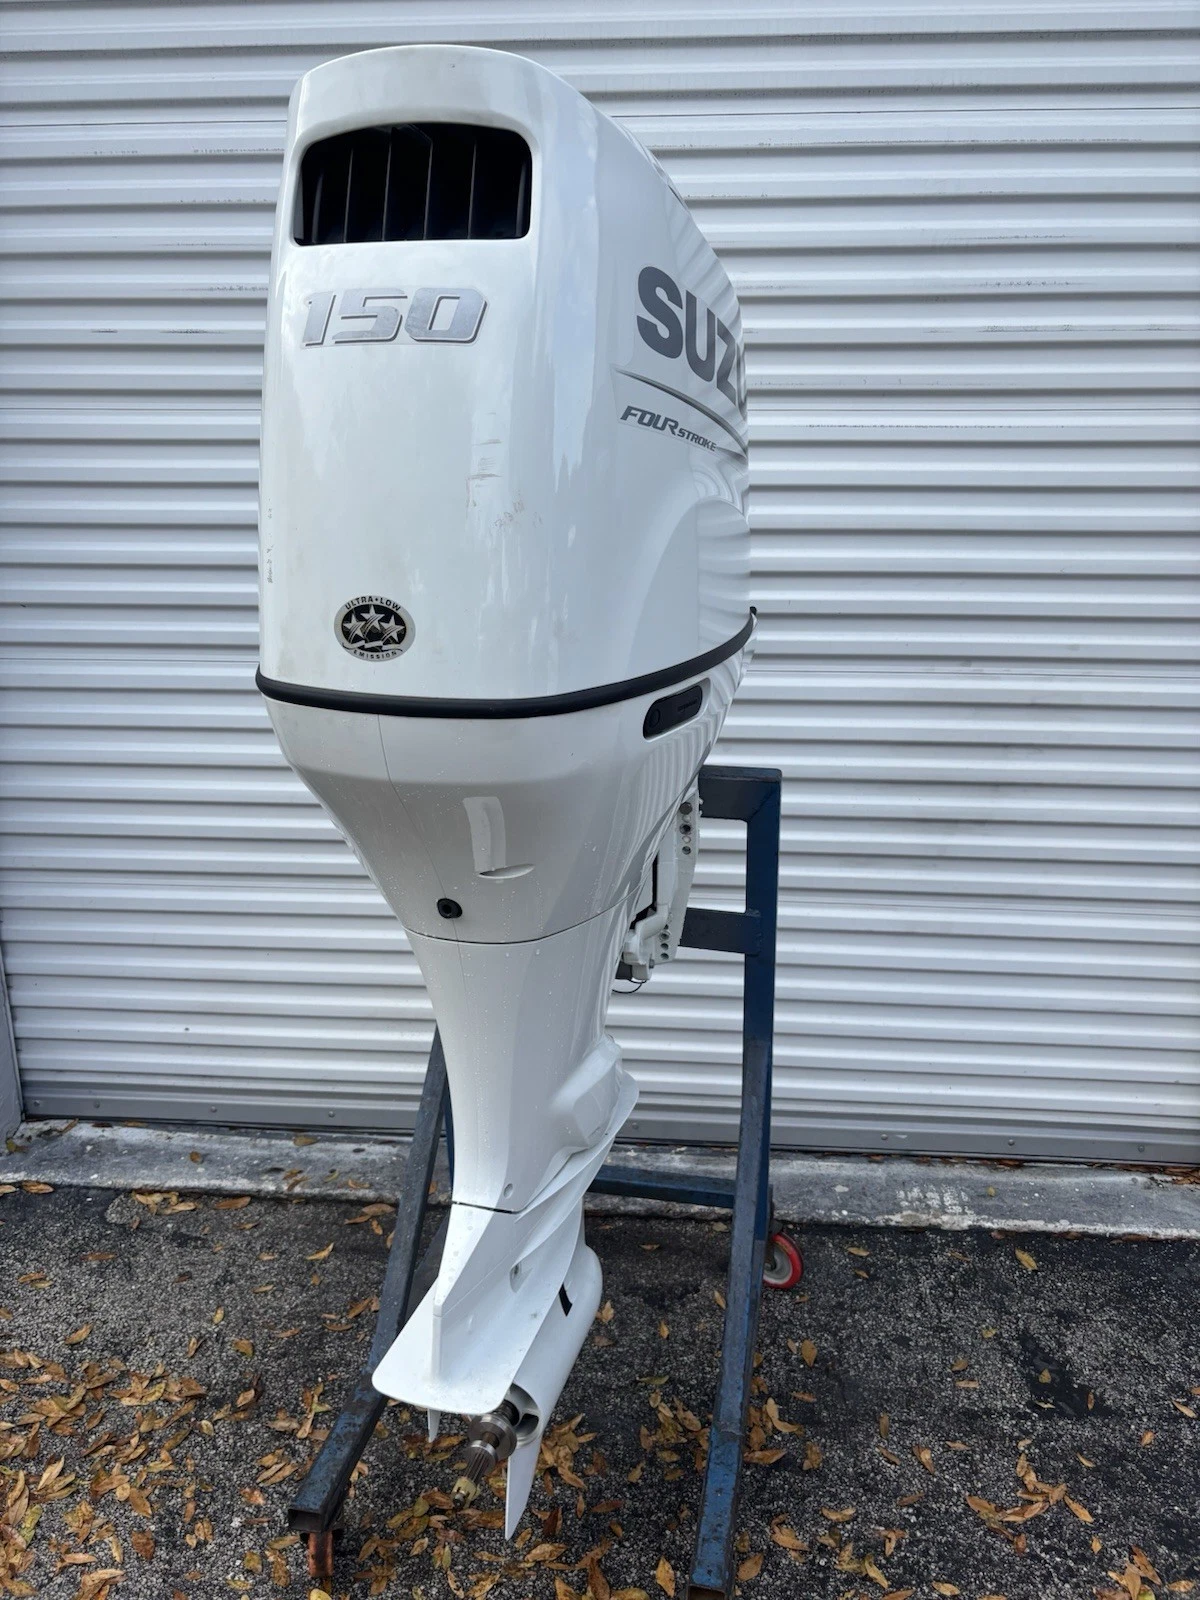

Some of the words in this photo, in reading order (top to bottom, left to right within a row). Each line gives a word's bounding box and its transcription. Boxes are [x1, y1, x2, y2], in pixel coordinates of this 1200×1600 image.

[301, 286, 487, 346] 150
[620, 405, 679, 436] FOUR
[677, 427, 716, 452] STROKE
[353, 649, 397, 659] EMISSION
